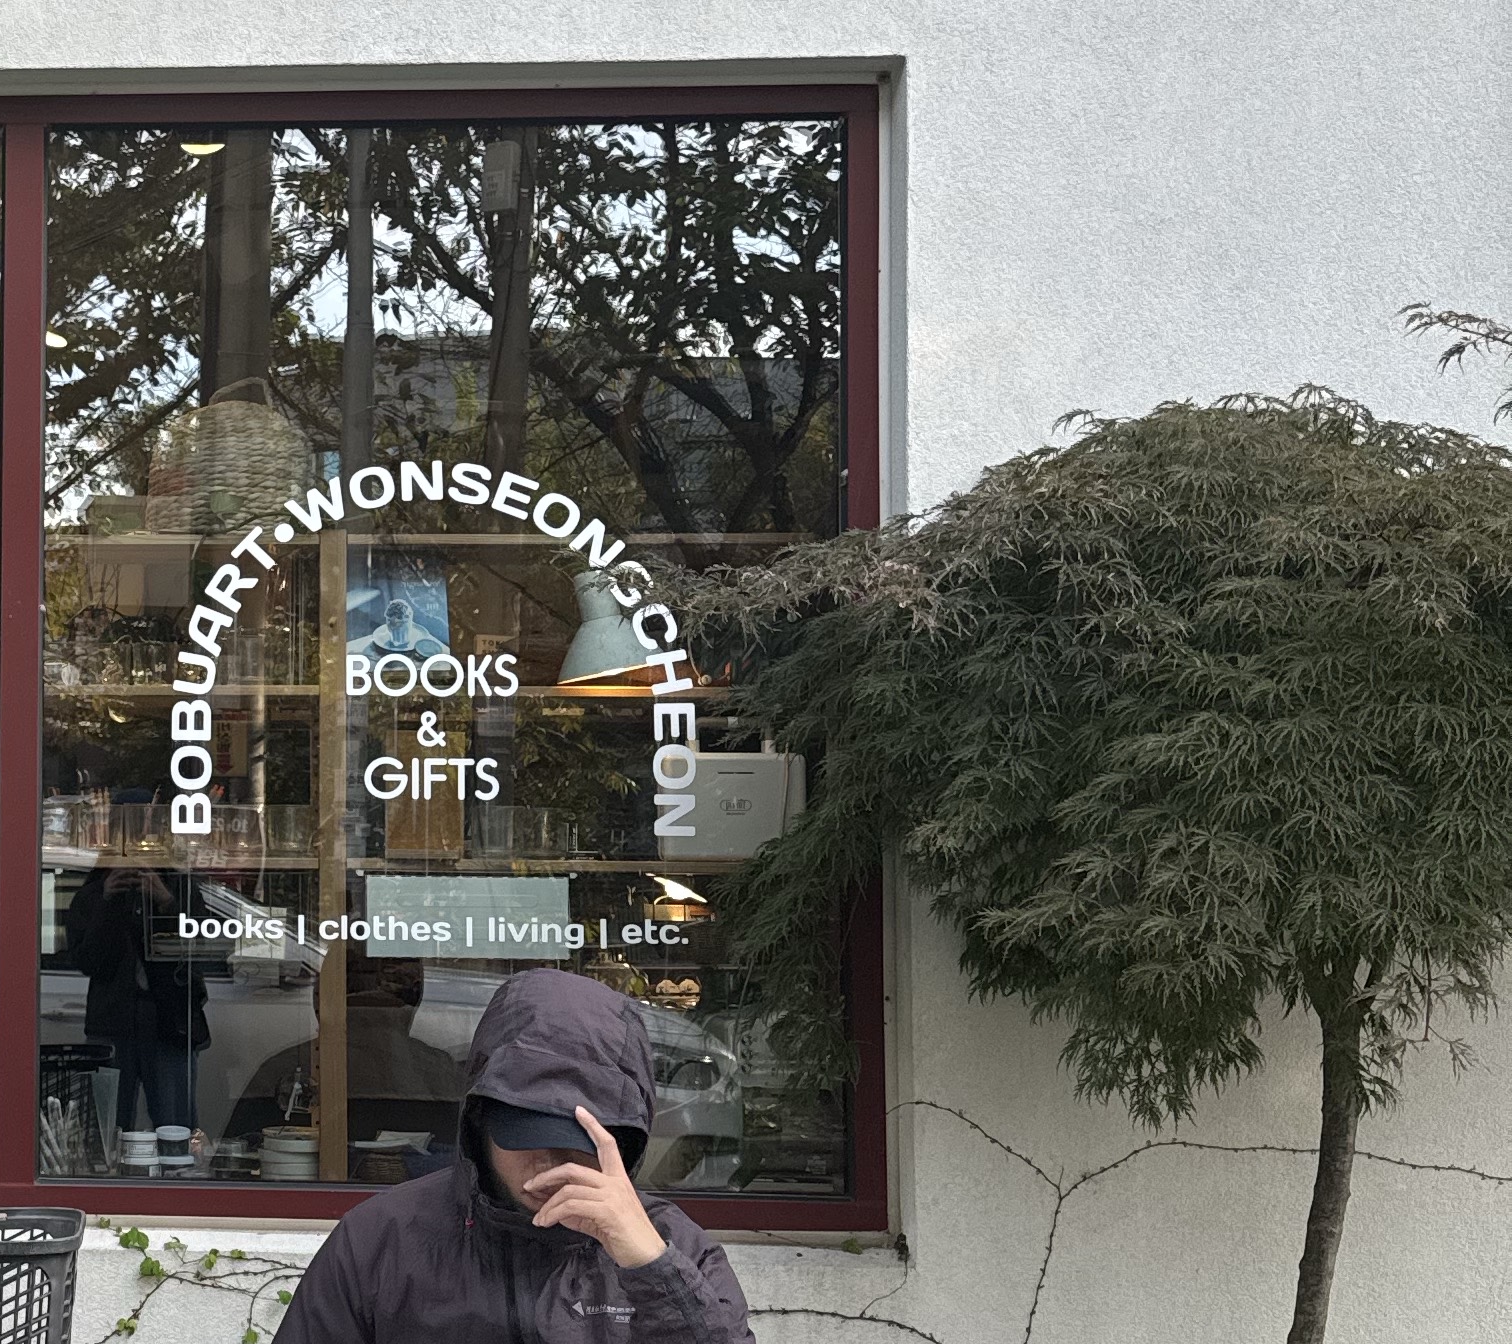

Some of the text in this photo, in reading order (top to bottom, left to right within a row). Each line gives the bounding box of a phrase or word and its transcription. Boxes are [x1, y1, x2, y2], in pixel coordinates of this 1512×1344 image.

[170, 460, 700, 837] BOBUART WONSEONGCHEON
[345, 653, 519, 698] BOOKS
[416, 710, 447, 748] &
[363, 756, 500, 801] GIFTS
[178, 912, 284, 940] books
[318, 914, 452, 943] clothes
[488, 916, 586, 949] living
[621, 919, 690, 946] etc.
